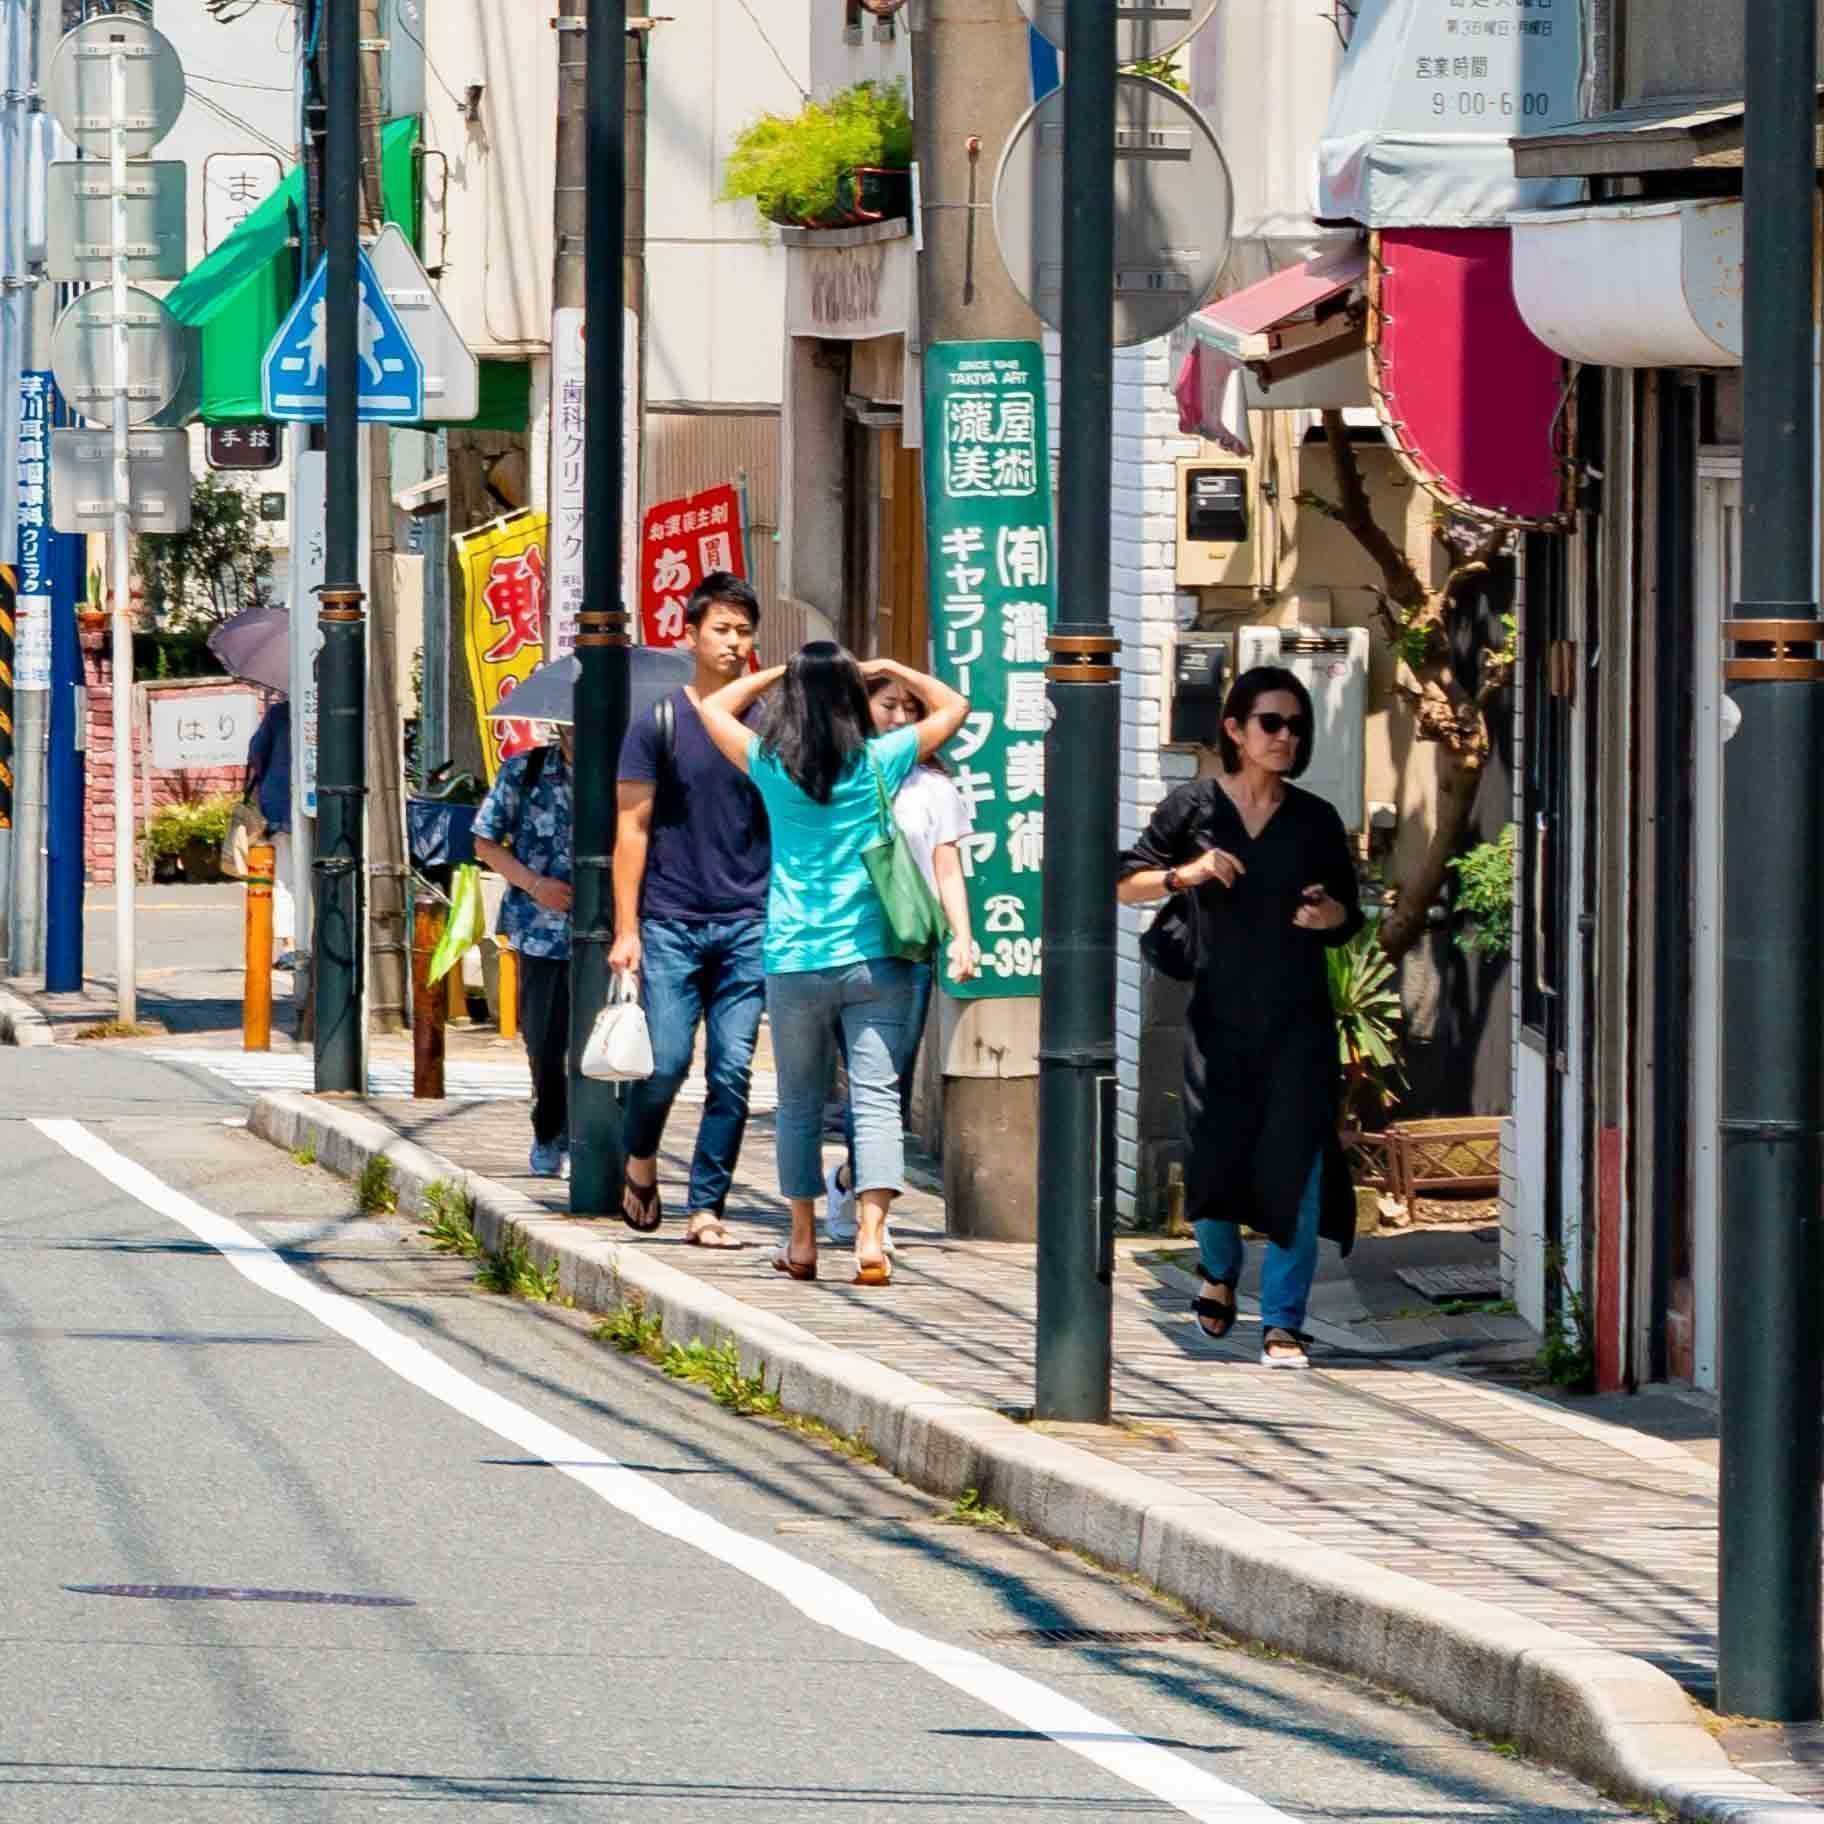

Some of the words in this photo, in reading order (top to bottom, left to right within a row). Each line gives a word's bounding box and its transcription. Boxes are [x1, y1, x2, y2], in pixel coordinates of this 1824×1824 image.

[1415, 56, 1489, 80] 営業時間
[1002, 371, 1029, 384] ART
[218, 428, 272, 449] 手技
[561, 378, 585, 562] 歯科クリニック
[176, 713, 236, 742] はり
